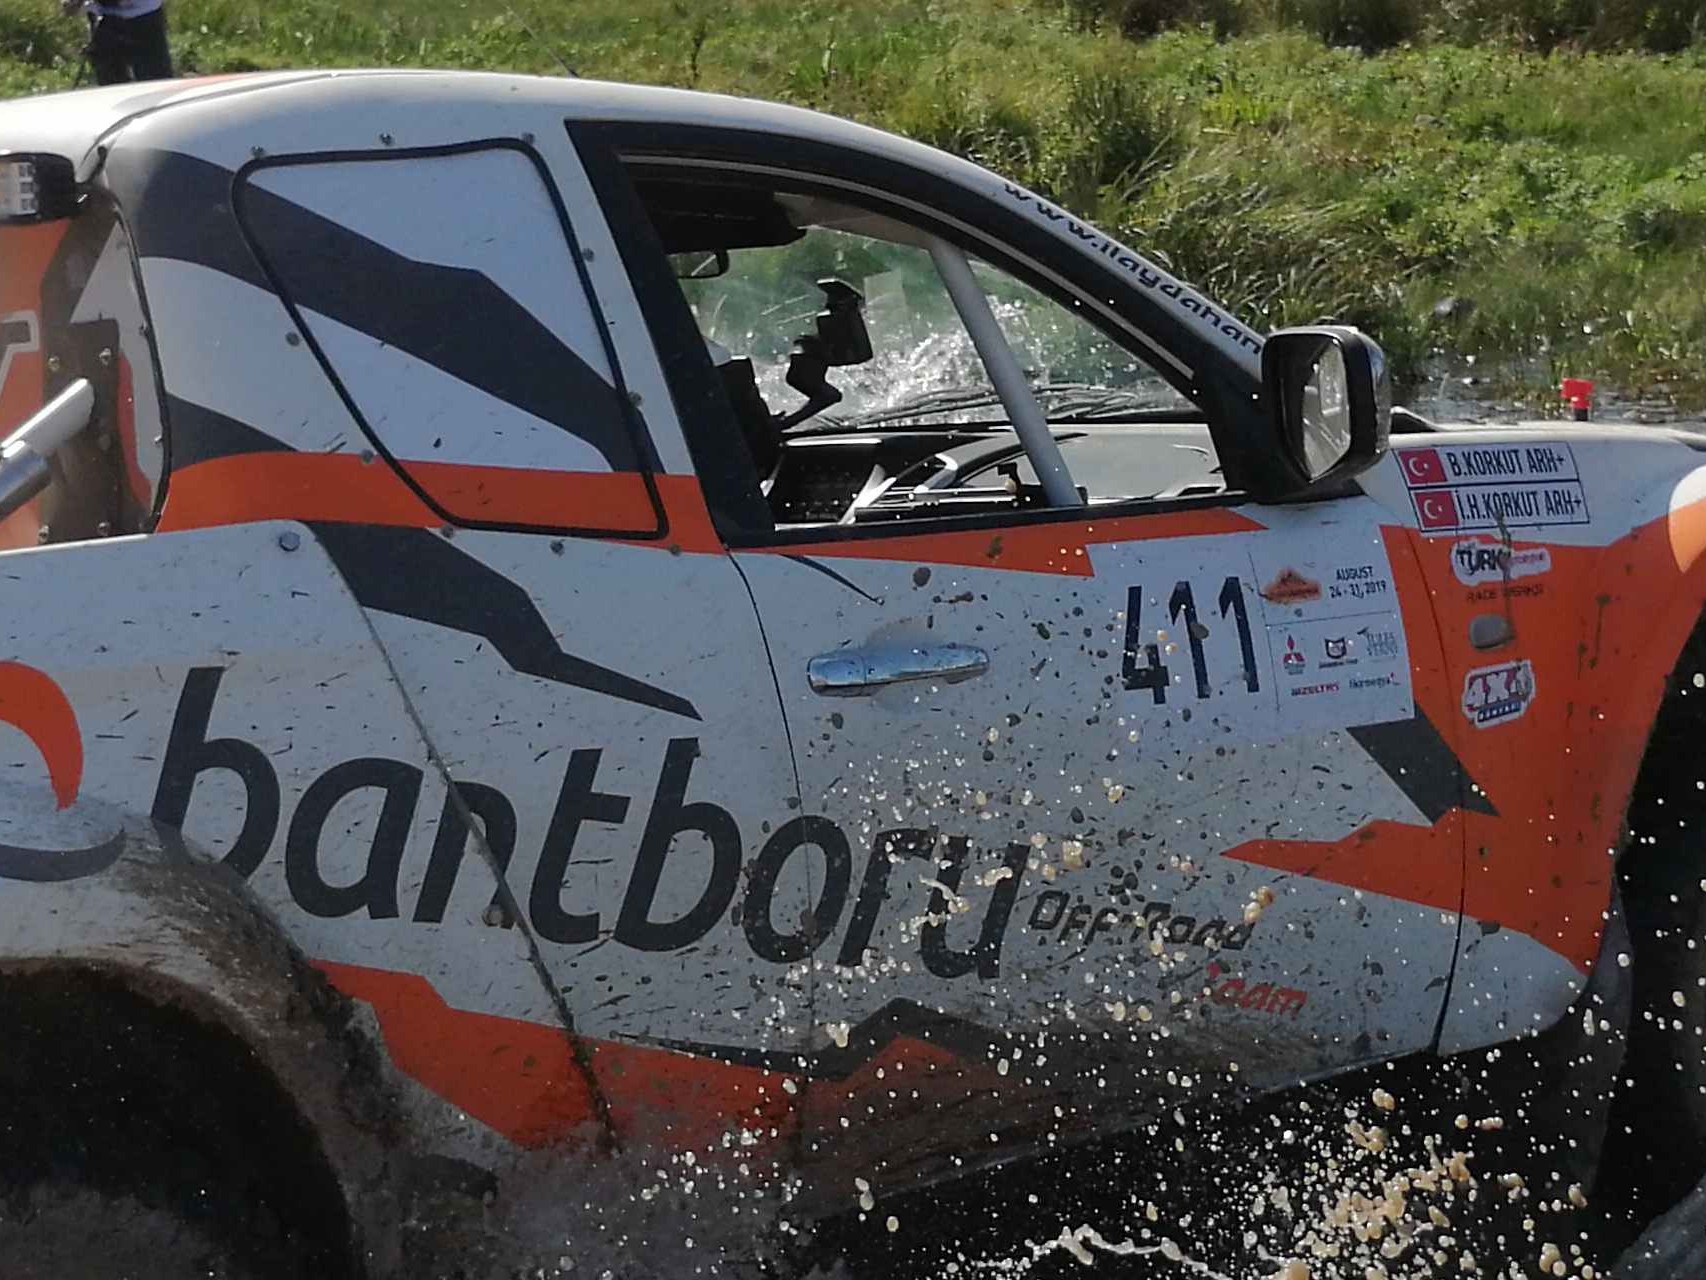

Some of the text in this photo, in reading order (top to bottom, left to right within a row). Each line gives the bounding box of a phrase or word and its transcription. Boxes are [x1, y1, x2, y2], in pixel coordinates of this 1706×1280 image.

[1446, 448, 1565, 477] B.KORKUT ARH+
[1544, 489, 1582, 516] ARH+
[1336, 565, 1374, 580] AUGUST
[1365, 580, 1387, 597] 2019
[1122, 577, 1260, 705] 411
[150, 665, 1031, 979] bantboru
